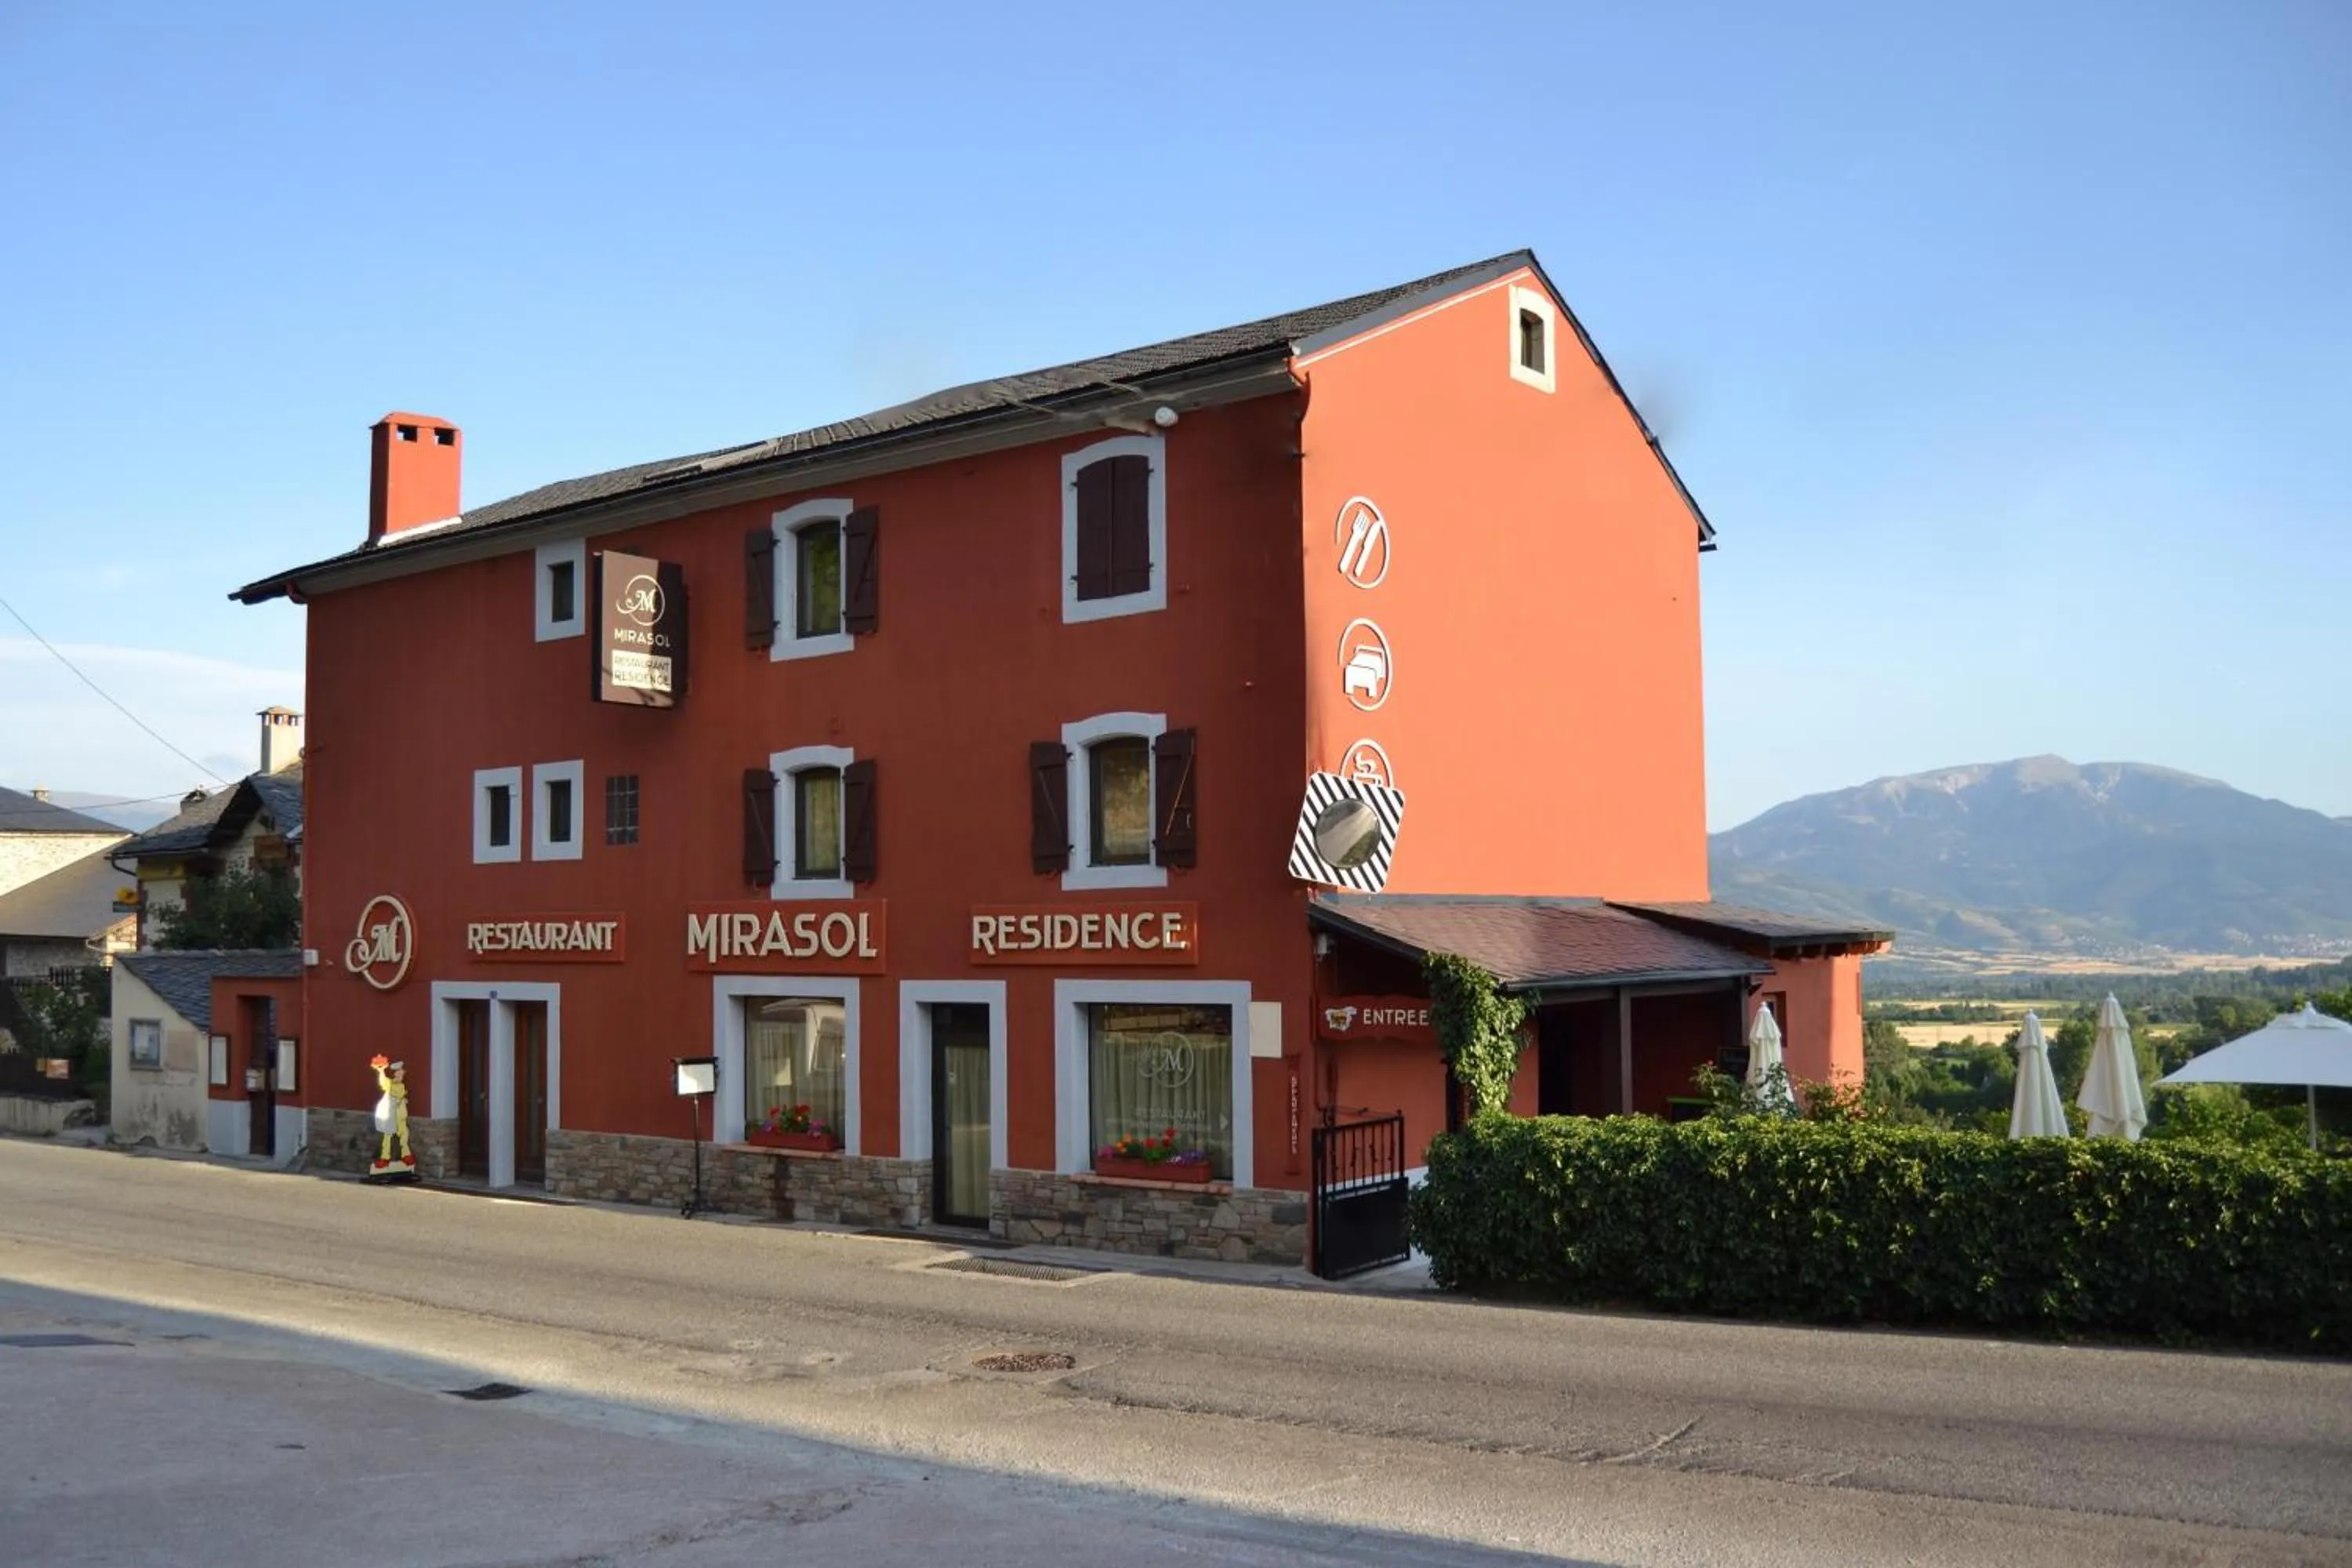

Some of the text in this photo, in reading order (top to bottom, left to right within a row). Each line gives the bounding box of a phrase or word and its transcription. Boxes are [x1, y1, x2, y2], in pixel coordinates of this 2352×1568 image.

[614, 628, 671, 648] MIRASOL
[468, 920, 617, 954] RESTAURANT
[688, 909, 878, 964] MIRASOL
[973, 912, 1190, 955] RESIDENCE
[1363, 1008, 1430, 1026] ENTREE
